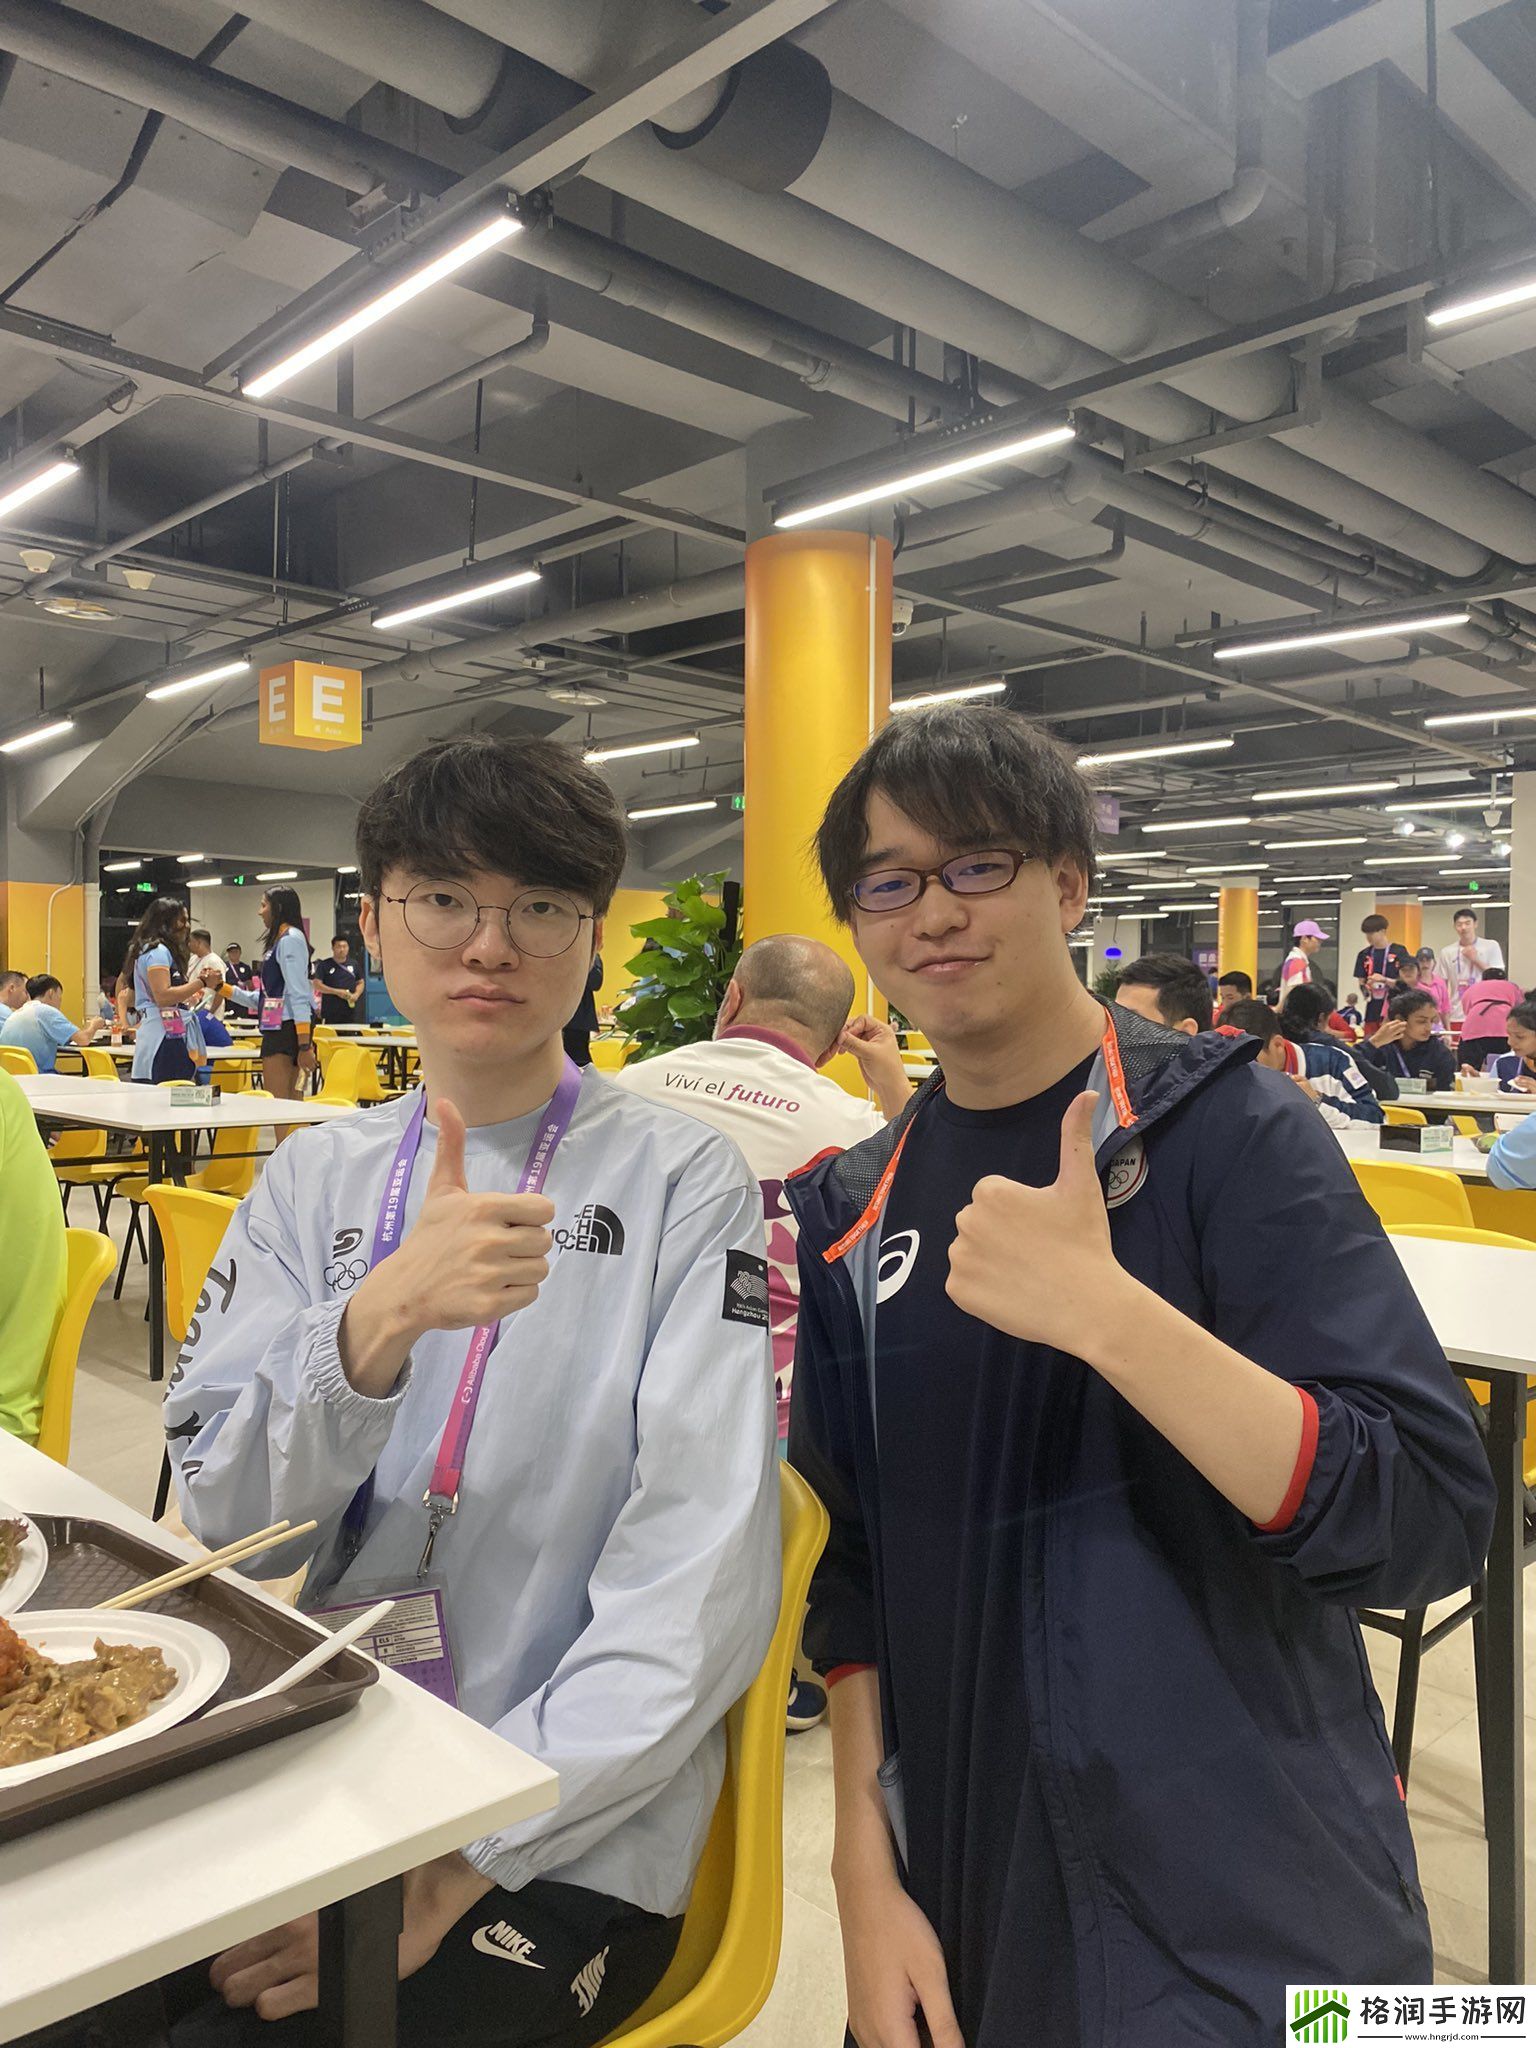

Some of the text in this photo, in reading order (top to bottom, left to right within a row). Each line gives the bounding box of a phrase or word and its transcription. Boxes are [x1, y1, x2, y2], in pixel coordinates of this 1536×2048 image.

[269, 675, 286, 723] E
[312, 675, 345, 724] E
[705, 1081, 726, 1096] el
[724, 1084, 801, 1113] futuro
[524, 1123, 559, 1193] 州第19届亚运会
[467, 1327, 490, 1386] Alibaba Cloud
[488, 1920, 537, 1960] NIKE
